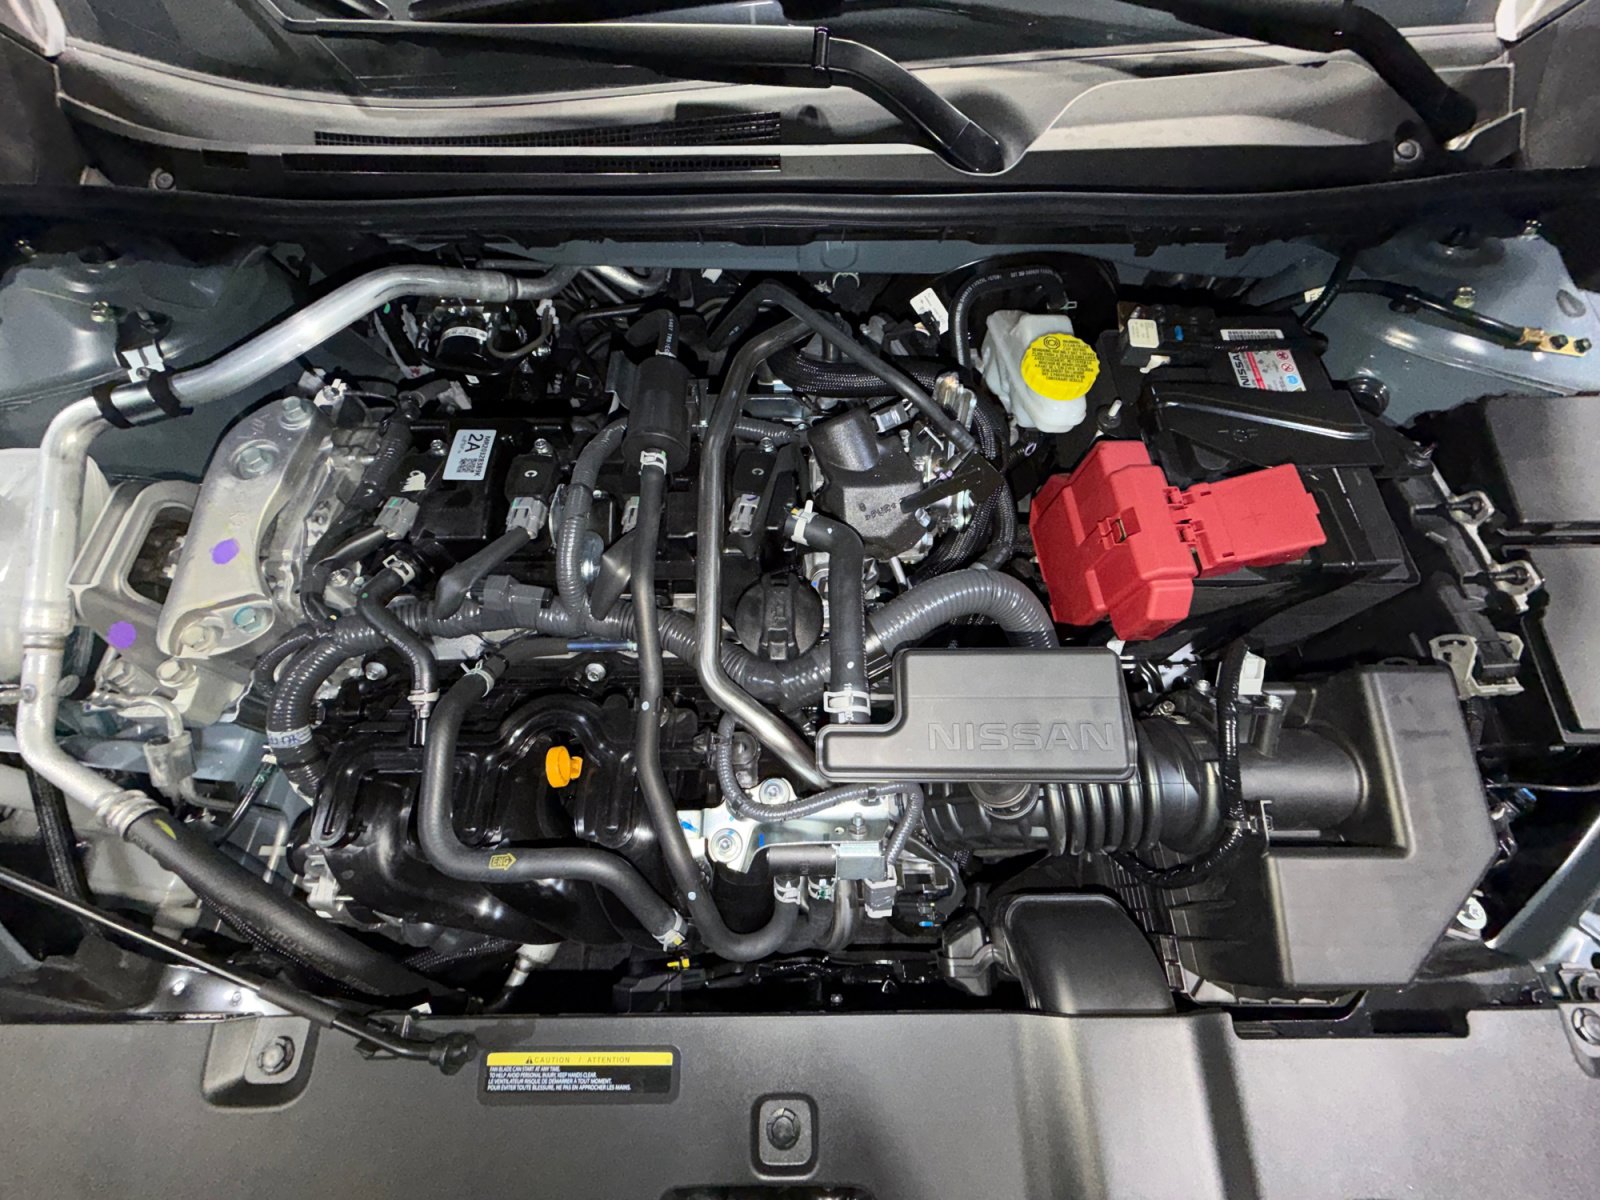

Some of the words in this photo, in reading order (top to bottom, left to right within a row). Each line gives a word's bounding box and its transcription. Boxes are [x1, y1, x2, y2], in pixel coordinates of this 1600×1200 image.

[1233, 351, 1250, 386] NISSA
[465, 434, 484, 452] 2A
[928, 723, 1113, 750] NISSAN
